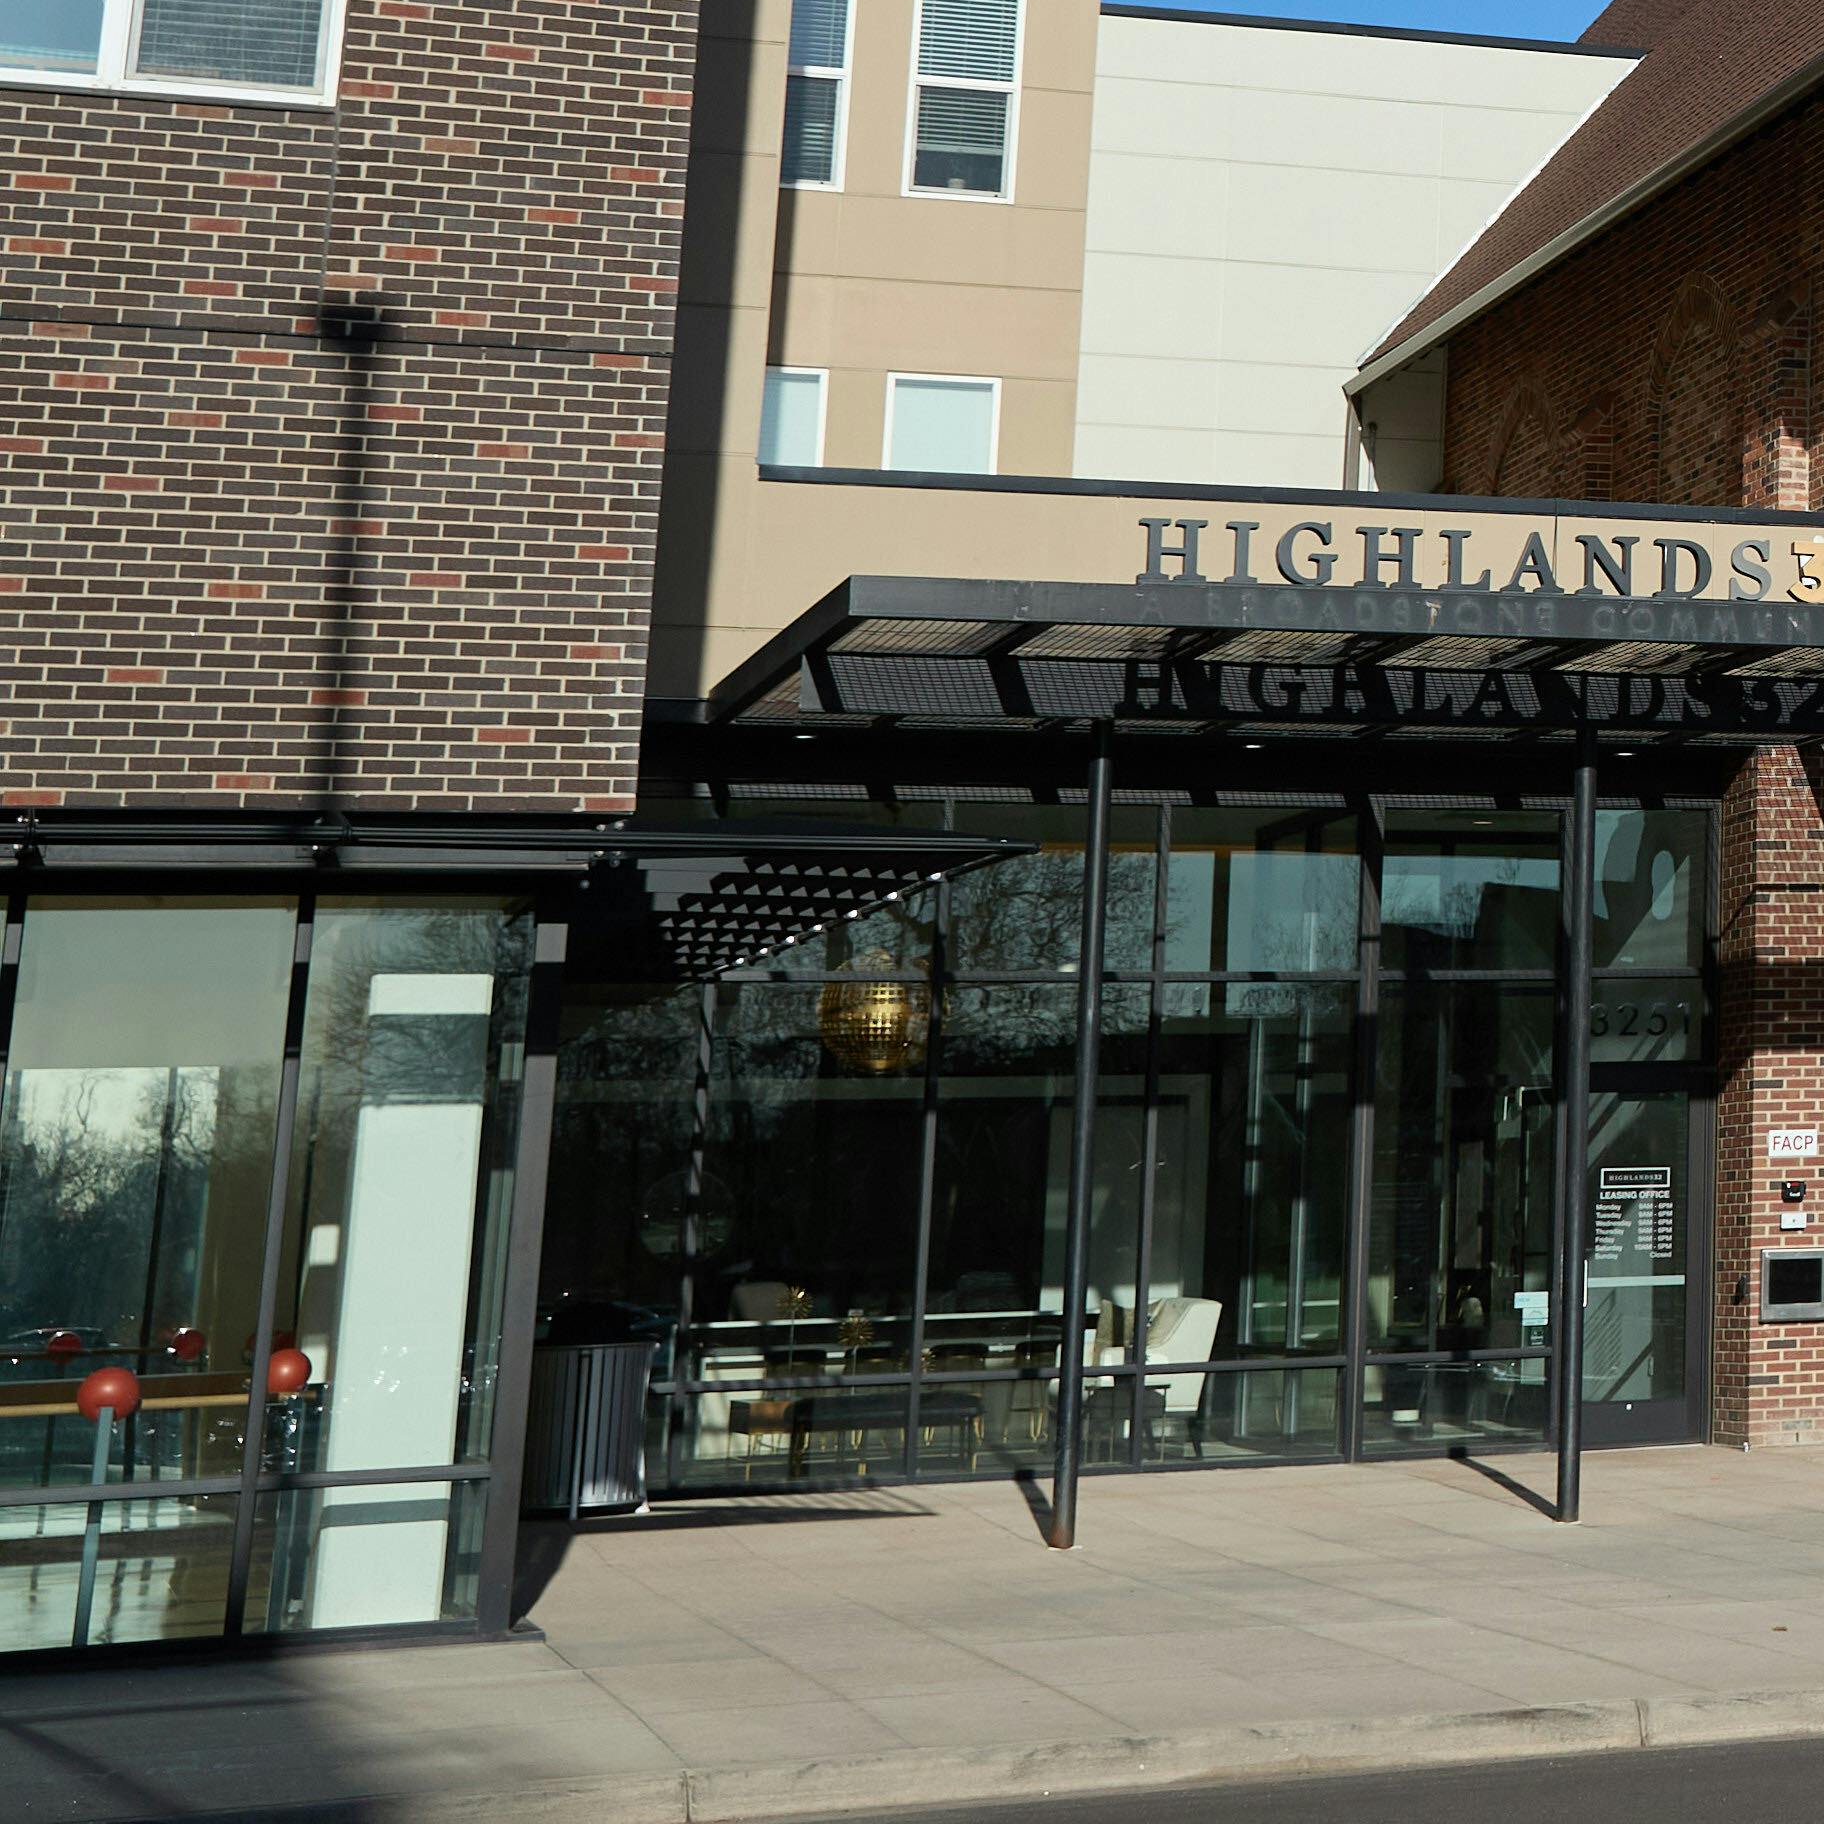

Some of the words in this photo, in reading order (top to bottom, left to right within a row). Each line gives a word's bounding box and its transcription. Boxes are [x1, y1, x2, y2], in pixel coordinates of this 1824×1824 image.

[1590, 1001, 1690, 1037] 3251
[1773, 1135, 1814, 1151] FACP
[1600, 1191, 1638, 1199] LEASING
[1639, 1190, 1670, 1198] OFFICE
[1649, 1251, 1672, 1259] Closed
